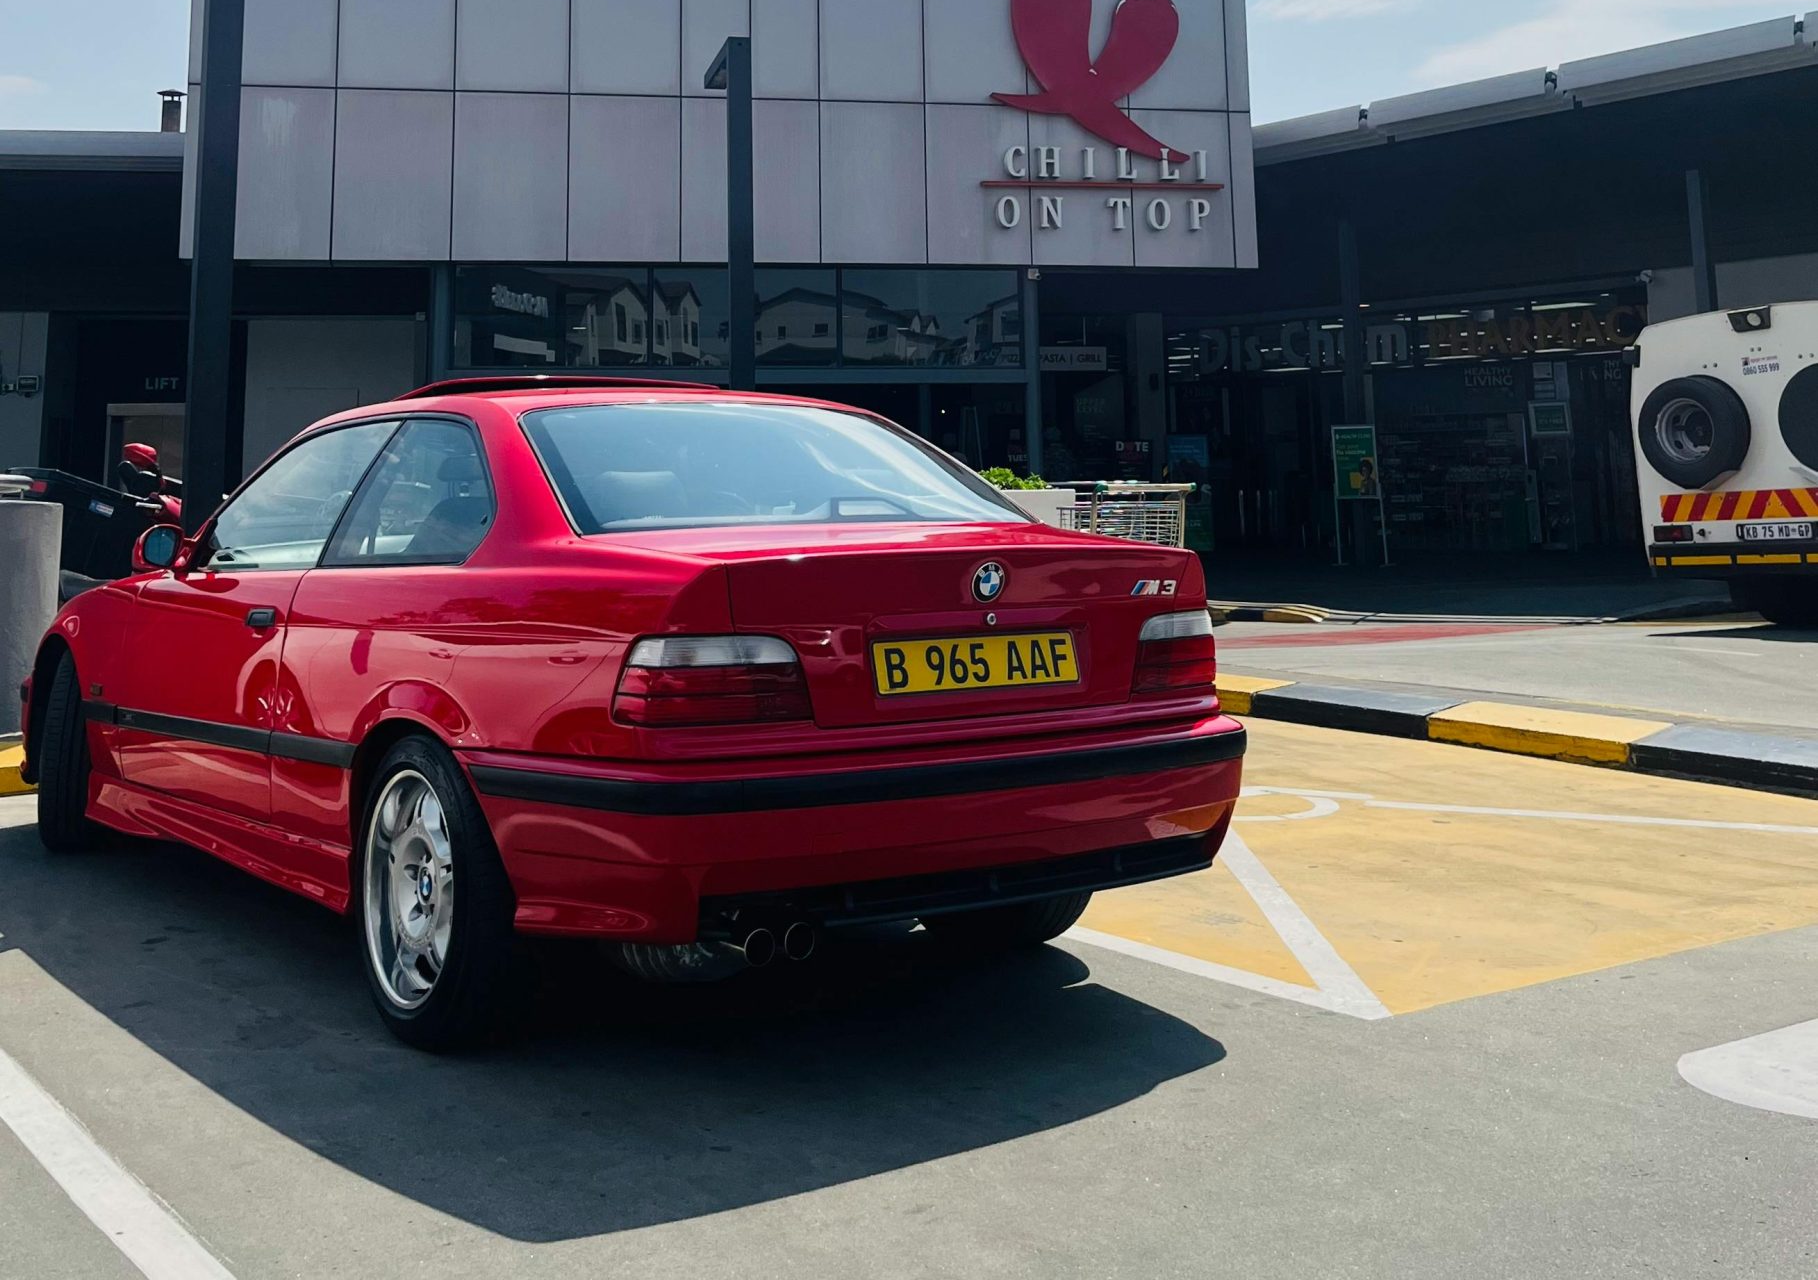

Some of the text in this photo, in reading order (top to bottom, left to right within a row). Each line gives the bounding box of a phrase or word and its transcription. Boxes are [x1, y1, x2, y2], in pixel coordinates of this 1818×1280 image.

[1003, 145, 1208, 181] CHILLI
[996, 195, 1211, 231] ON TOP
[1463, 366, 1512, 375] HEALTHY
[145, 377, 179, 390] LIFT
[1464, 375, 1513, 387] LIVING
[1745, 527, 1758, 539] KB
[1762, 526, 1774, 538] 75
[1798, 524, 1810, 537] GP
[1131, 579, 1177, 596] M3
[884, 638, 1068, 689] B 965 AAF
